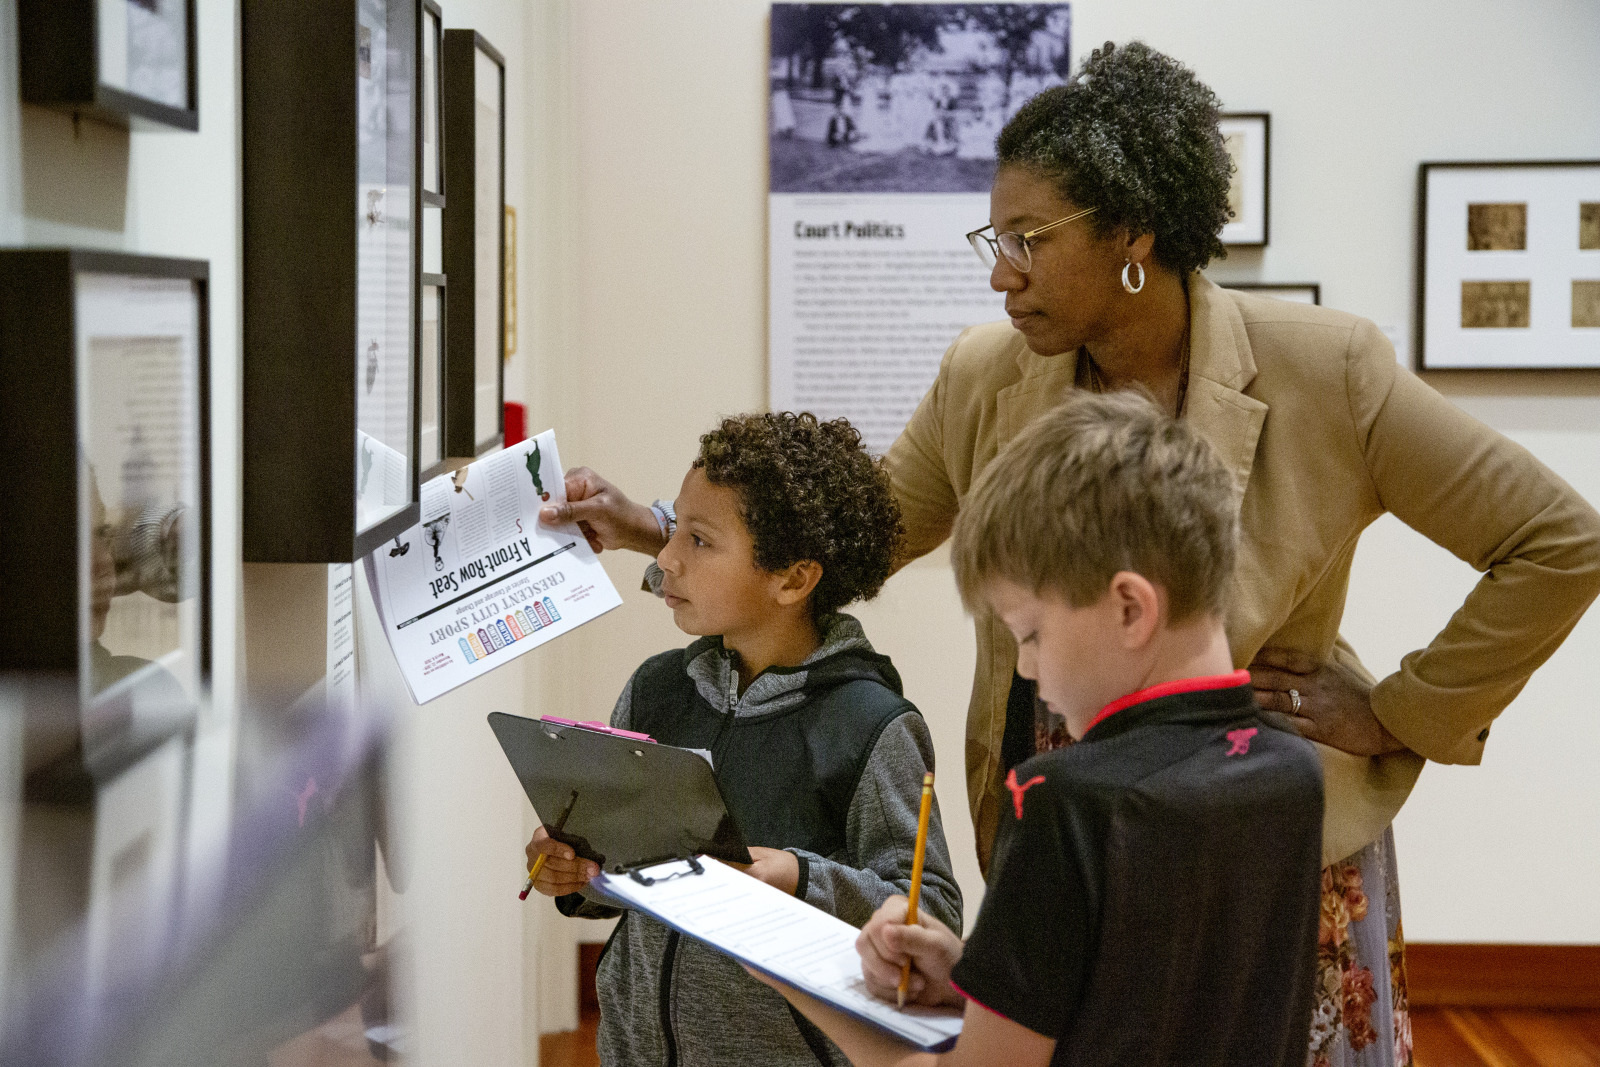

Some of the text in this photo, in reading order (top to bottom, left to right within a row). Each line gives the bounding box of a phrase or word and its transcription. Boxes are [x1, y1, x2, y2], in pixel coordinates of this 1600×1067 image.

[794, 220, 904, 238] Court Politics
[519, 537, 532, 556] A
[459, 542, 522, 583] Front-Row
[428, 571, 459, 599] Seat
[456, 577, 530, 615] Stories of Courage and Change
[501, 571, 565, 610] CRESCENT
[470, 602, 500, 625] CITY
[528, 608, 542, 629] TENNIS
[537, 603, 551, 625] FOOTBALL
[546, 599, 560, 620] ROWING
[429, 616, 469, 645] SPORT
[499, 621, 513, 643] SAILING
[518, 612, 532, 634] BOXING
[490, 626, 504, 647] CYCLING
